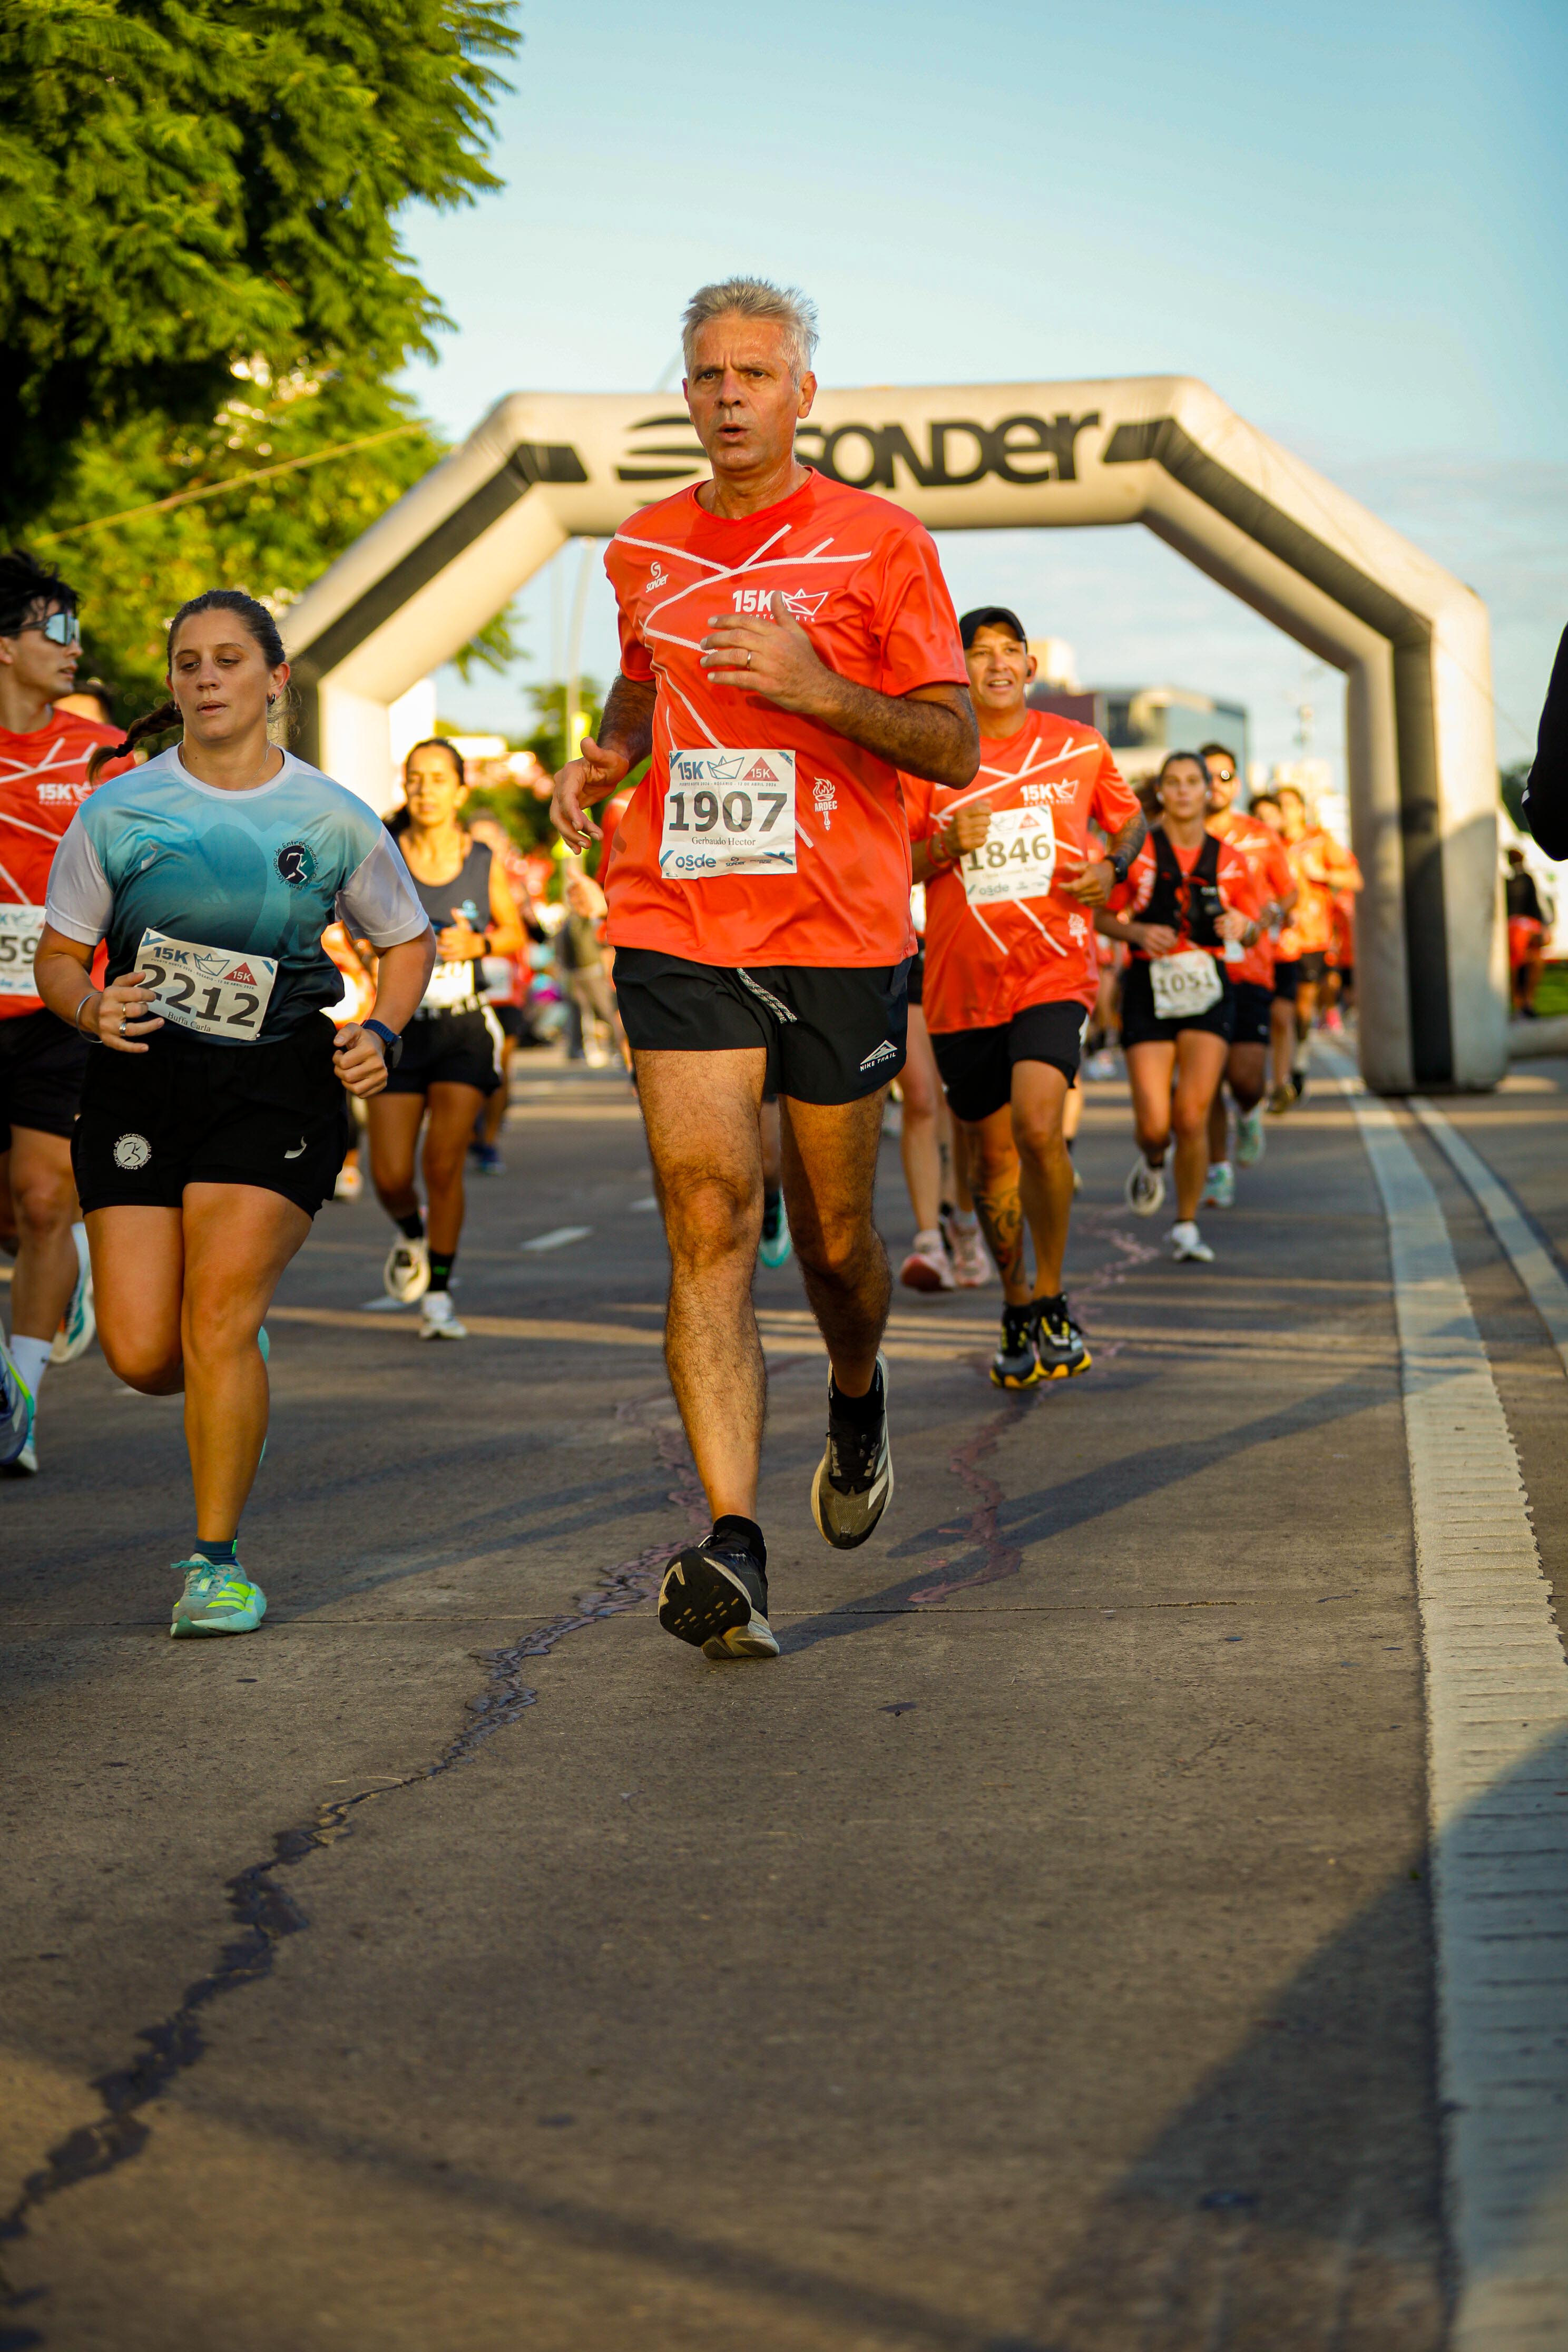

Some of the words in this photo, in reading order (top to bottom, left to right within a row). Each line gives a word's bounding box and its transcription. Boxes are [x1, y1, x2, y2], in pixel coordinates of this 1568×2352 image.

[732, 590, 776, 612] 15K
[678, 761, 704, 780] 15K
[751, 768, 771, 779] 15K
[36, 783, 72, 800] 15K
[1020, 783, 1054, 801] 15K
[669, 791, 787, 832] 1907
[814, 800, 838, 812] ARDEC
[691, 837, 726, 845] Gerbaudo
[728, 837, 756, 846] Hector
[675, 852, 717, 870] osde
[967, 833, 1051, 871] 1846
[153, 946, 190, 965] 15K
[196, 972, 213, 981] ROSARIO
[233, 971, 251, 982] 15K
[136, 963, 259, 1027] 2212
[168, 1012, 188, 1025] Buffa
[190, 1021, 211, 1032] Carla
[860, 1061, 875, 1072] NIKE
[877, 1052, 896, 1064] TRAIL
